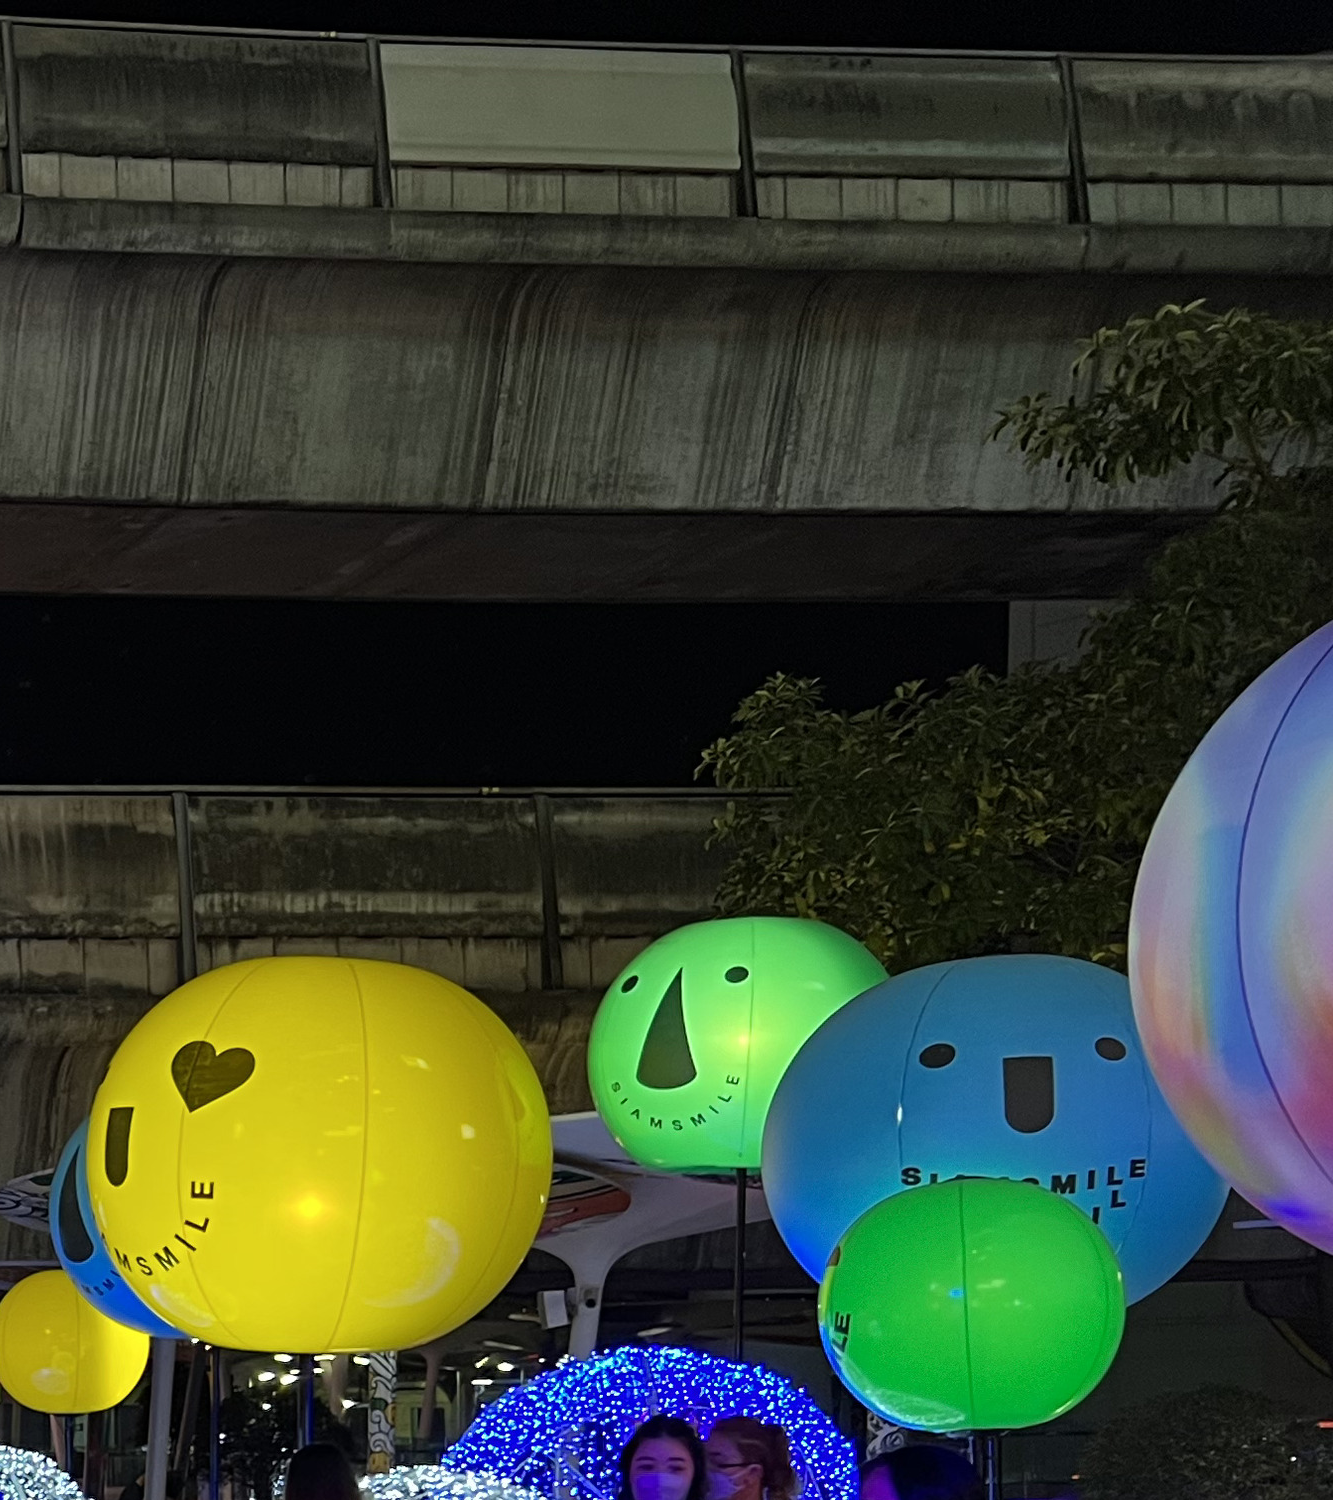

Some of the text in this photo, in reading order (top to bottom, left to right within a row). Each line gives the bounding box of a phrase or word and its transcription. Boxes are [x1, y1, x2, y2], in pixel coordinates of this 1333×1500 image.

[611, 1075, 740, 1131] SIAMSMILE
[901, 1159, 1146, 1194] SIMILE
[100, 1181, 214, 1276] MSMILE
